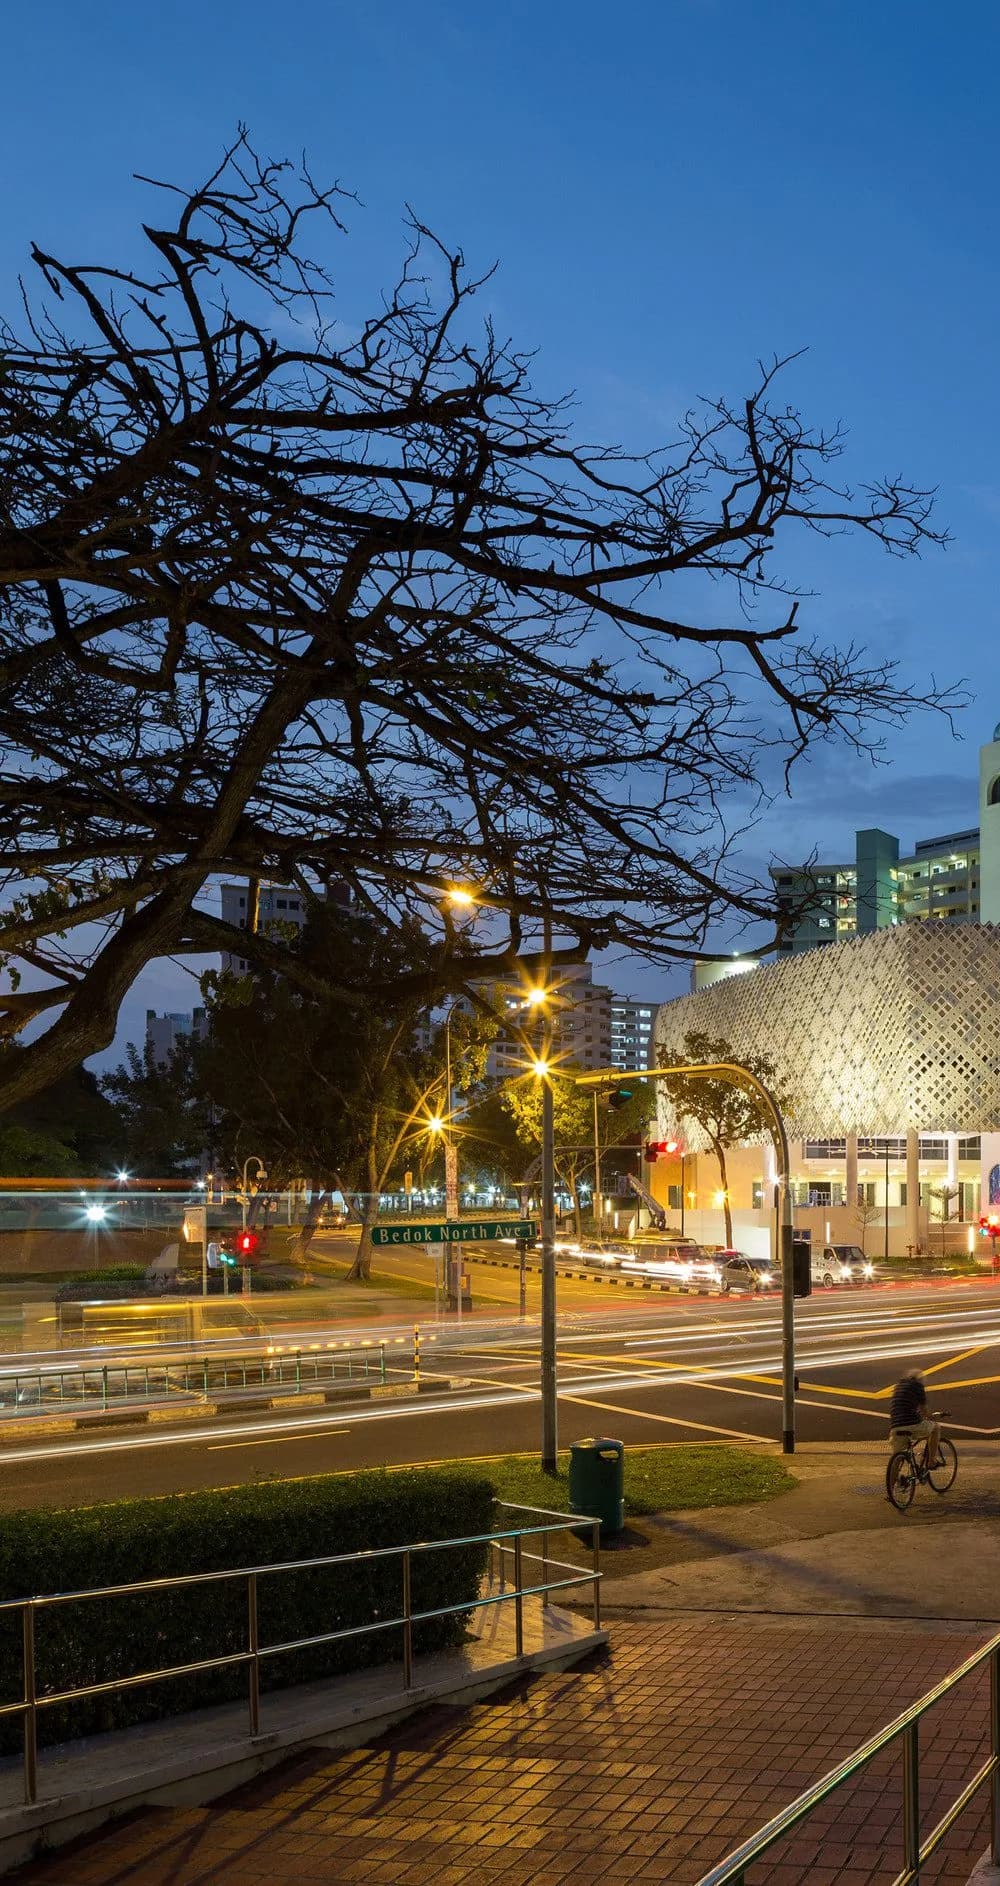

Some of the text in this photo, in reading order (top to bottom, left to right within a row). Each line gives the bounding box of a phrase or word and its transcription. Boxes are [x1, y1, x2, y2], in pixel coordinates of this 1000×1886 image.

[379, 1227, 432, 1243] Bedok
[440, 1225, 487, 1241] North
[494, 1224, 521, 1238] Ave
